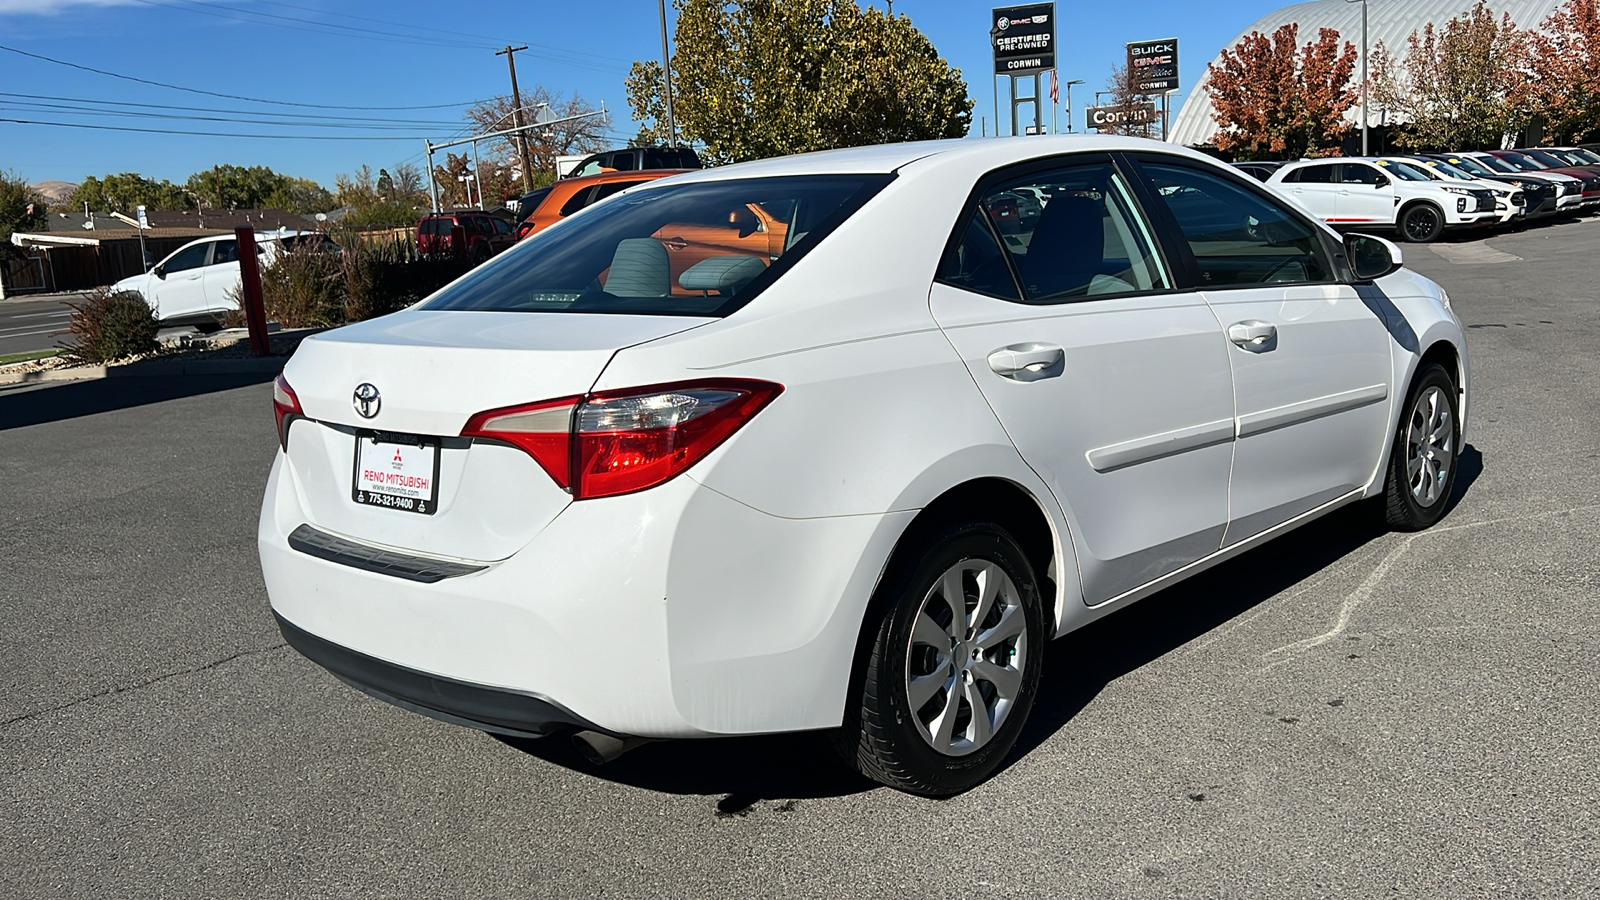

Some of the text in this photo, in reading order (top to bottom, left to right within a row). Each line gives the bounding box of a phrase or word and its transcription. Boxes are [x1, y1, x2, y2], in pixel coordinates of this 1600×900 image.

[997, 34, 1050, 45] CERTIFIED
[1000, 41, 1047, 51] PRE-OWNED
[1131, 44, 1173, 55] BUICK
[1007, 59, 1041, 69] CORWIN
[1133, 55, 1172, 67] GMC
[1139, 81, 1168, 90] CORWIN
[364, 470, 430, 490] RENO MITSUBISHI
[372, 484, 420, 497] www.renomits.com
[369, 493, 414, 510] 775-321-9400
